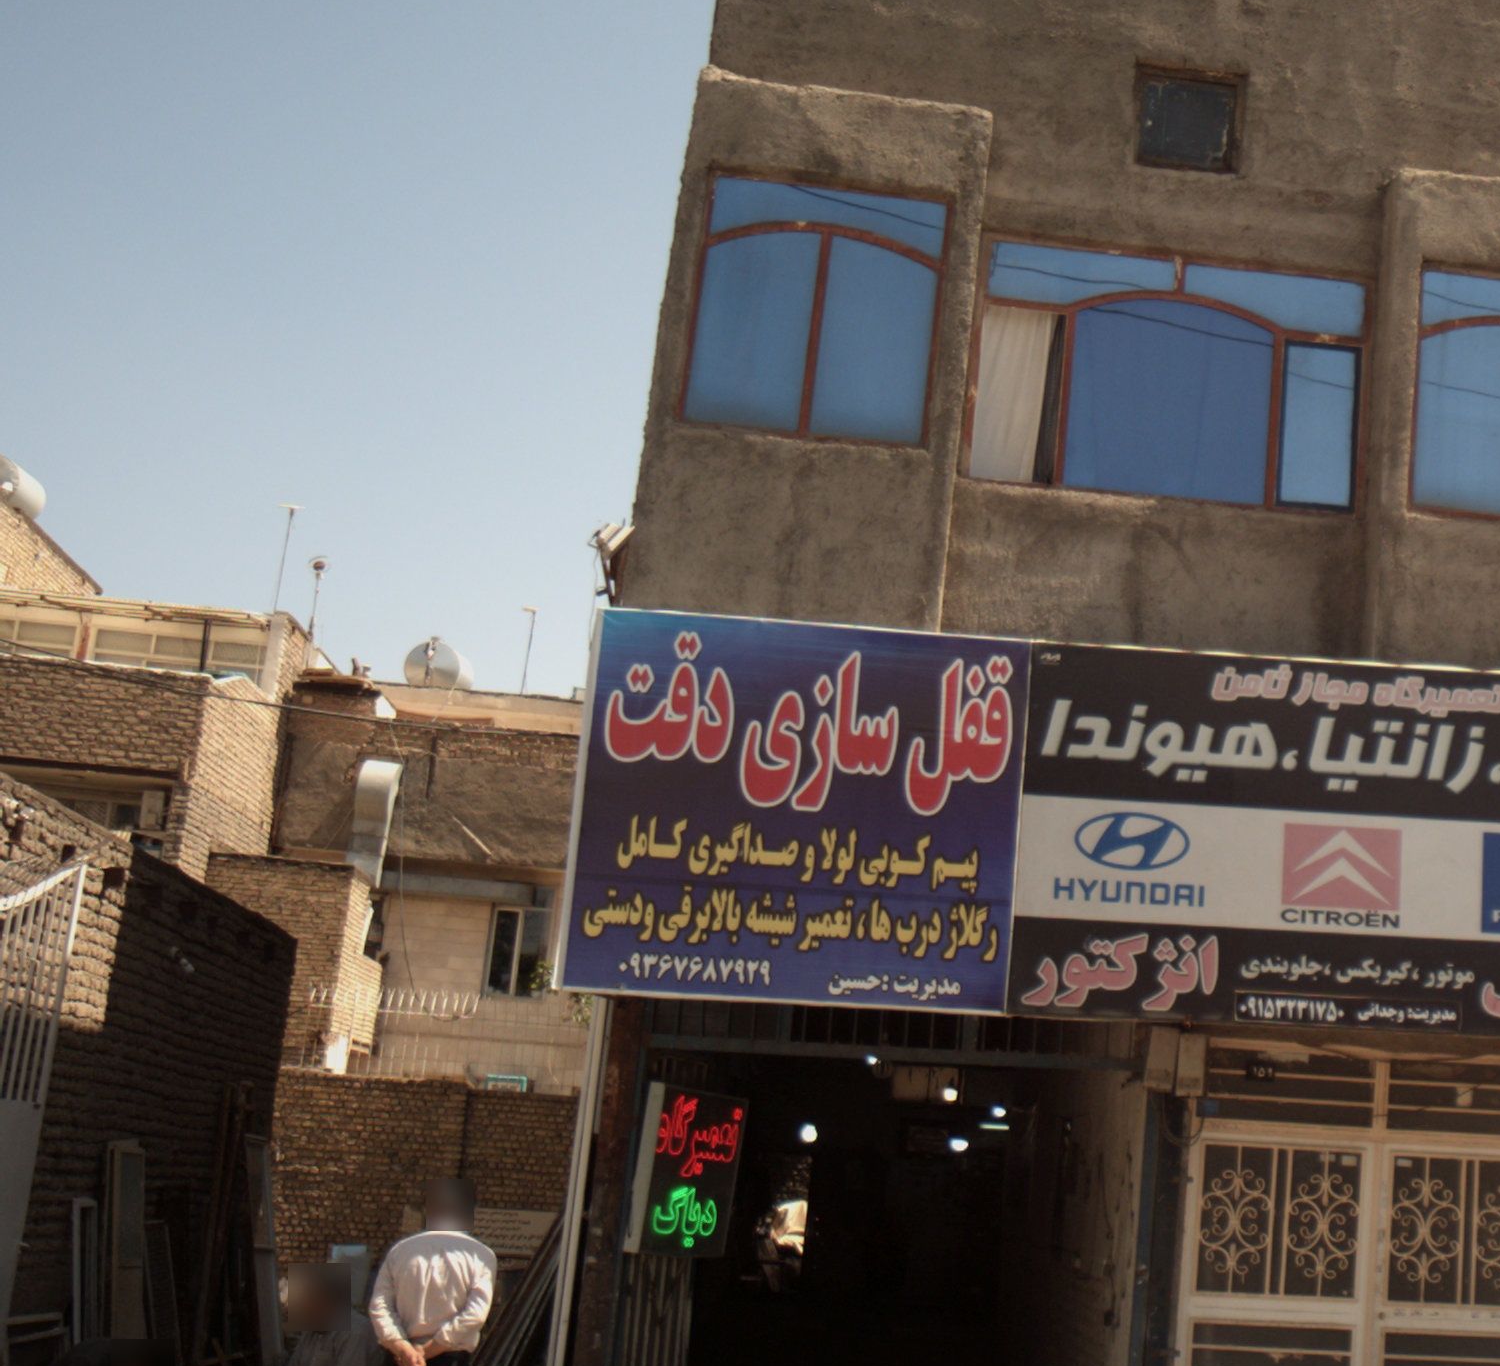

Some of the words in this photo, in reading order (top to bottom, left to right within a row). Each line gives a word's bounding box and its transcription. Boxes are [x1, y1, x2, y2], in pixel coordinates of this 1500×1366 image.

[605, 631, 734, 763] دقت
[1211, 664, 1293, 702] ثامن
[1291, 671, 1369, 711] مجاز
[740, 650, 899, 811] سازی
[905, 656, 1014, 816] قفل
[1040, 700, 1278, 783] هیوندا
[616, 815, 688, 870] کامل
[688, 821, 799, 876] صداگیری
[800, 844, 816, 882] و
[820, 828, 858, 884] لولا
[858, 835, 932, 888] کوبی
[931, 849, 979, 893] پیم
[1053, 877, 1206, 909] HYUNDAI
[745, 891, 797, 946] شیشه
[798, 900, 853, 952] تعمیر
[895, 908, 942, 958] درب
[1280, 908, 1401, 930] CITROËN
[618, 951, 771, 985] ۰۹۳۶۷۶۸۷۹۲۹
[893, 974, 961, 1001] مدیریت
[1020, 934, 1219, 1012] انژکتور
[1424, 963, 1475, 988] موتور
[1240, 996, 1345, 1022] ۰۹۱۵۳۲۳۱۷۵۰
[1357, 1003, 1404, 1023] وجدانی
[652, 1186, 718, 1249] دیاگ
